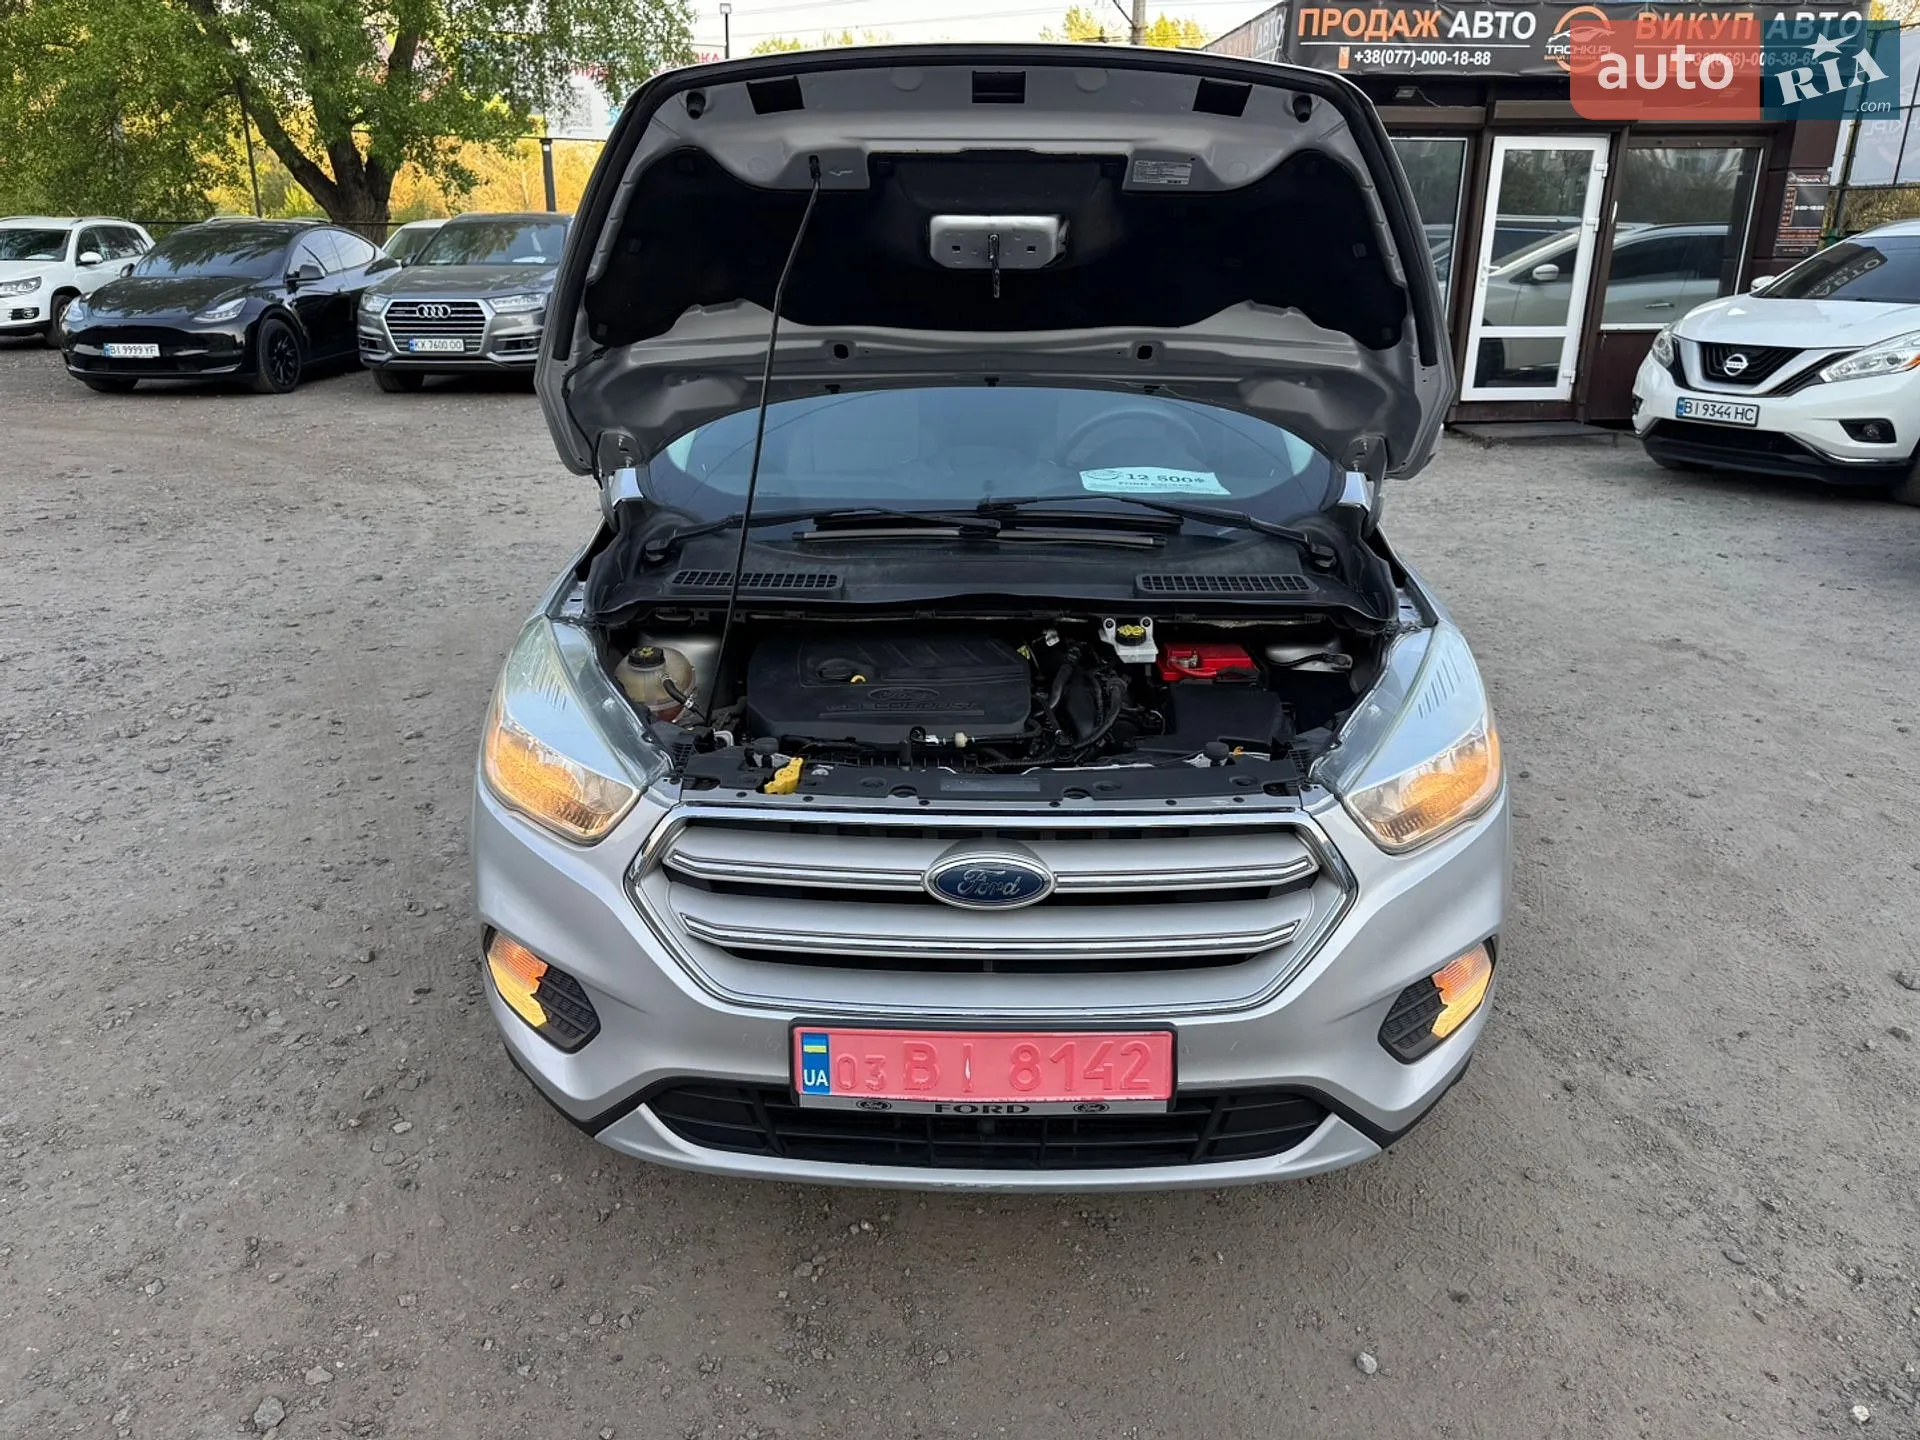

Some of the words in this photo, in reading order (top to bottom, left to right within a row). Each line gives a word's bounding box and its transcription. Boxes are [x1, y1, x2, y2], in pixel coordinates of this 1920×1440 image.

[1298, 8, 1442, 42] ПРОДАЖ
[1447, 10, 1537, 40] АВТО
[1635, 12, 1755, 40] ВИКУП
[1765, 11, 1863, 40] АВТО
[1354, 49, 1491, 67] +38(077)-000-18-88
[1684, 401, 1699, 415] BI
[1702, 403, 1731, 419] 9344
[1734, 407, 1754, 421] HC
[957, 869, 1021, 896] Ford
[835, 1054, 888, 1091] 03
[1008, 1040, 1153, 1092] 8142
[803, 1069, 829, 1087] UA
[934, 1103, 1030, 1114] FORD
